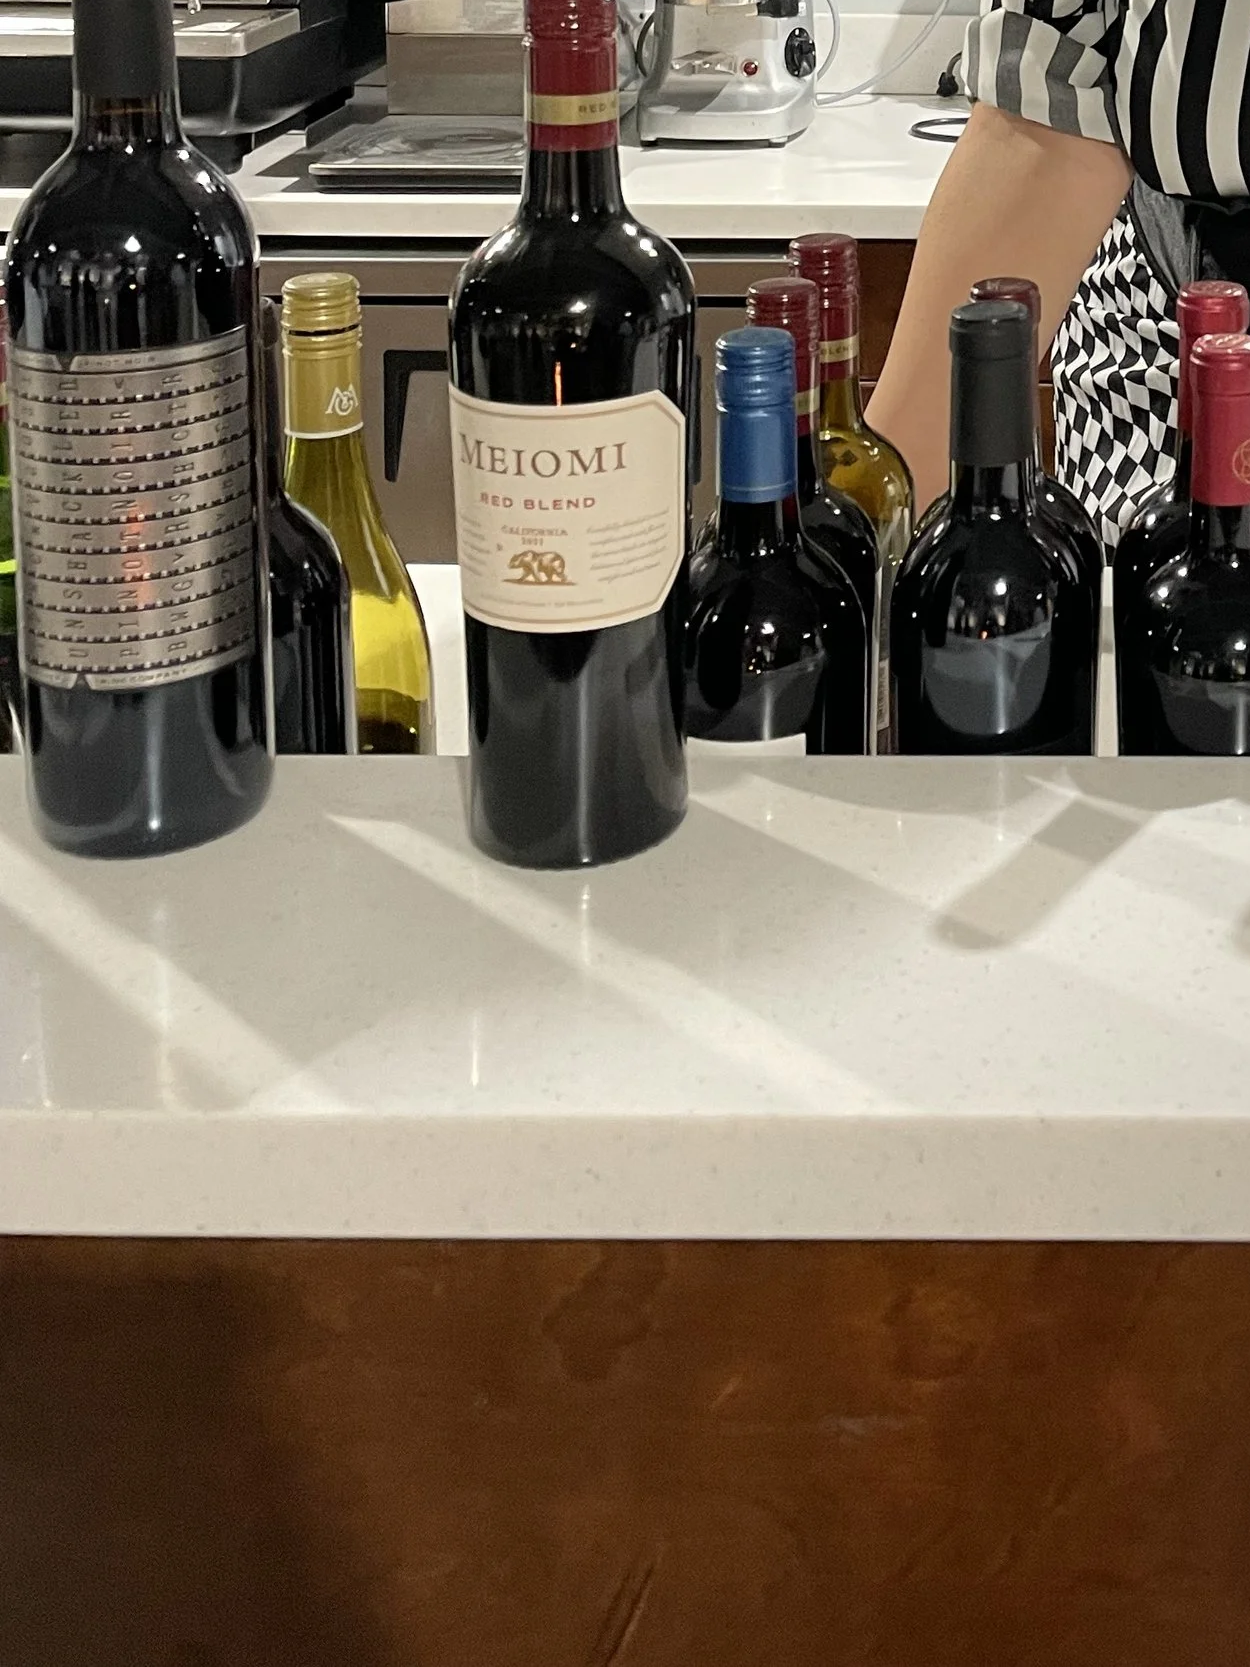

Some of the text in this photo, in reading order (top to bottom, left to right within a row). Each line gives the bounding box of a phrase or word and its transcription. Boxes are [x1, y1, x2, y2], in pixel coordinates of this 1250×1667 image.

[459, 433, 627, 478] MEIOMI
[480, 493, 596, 511] RED BLEND
